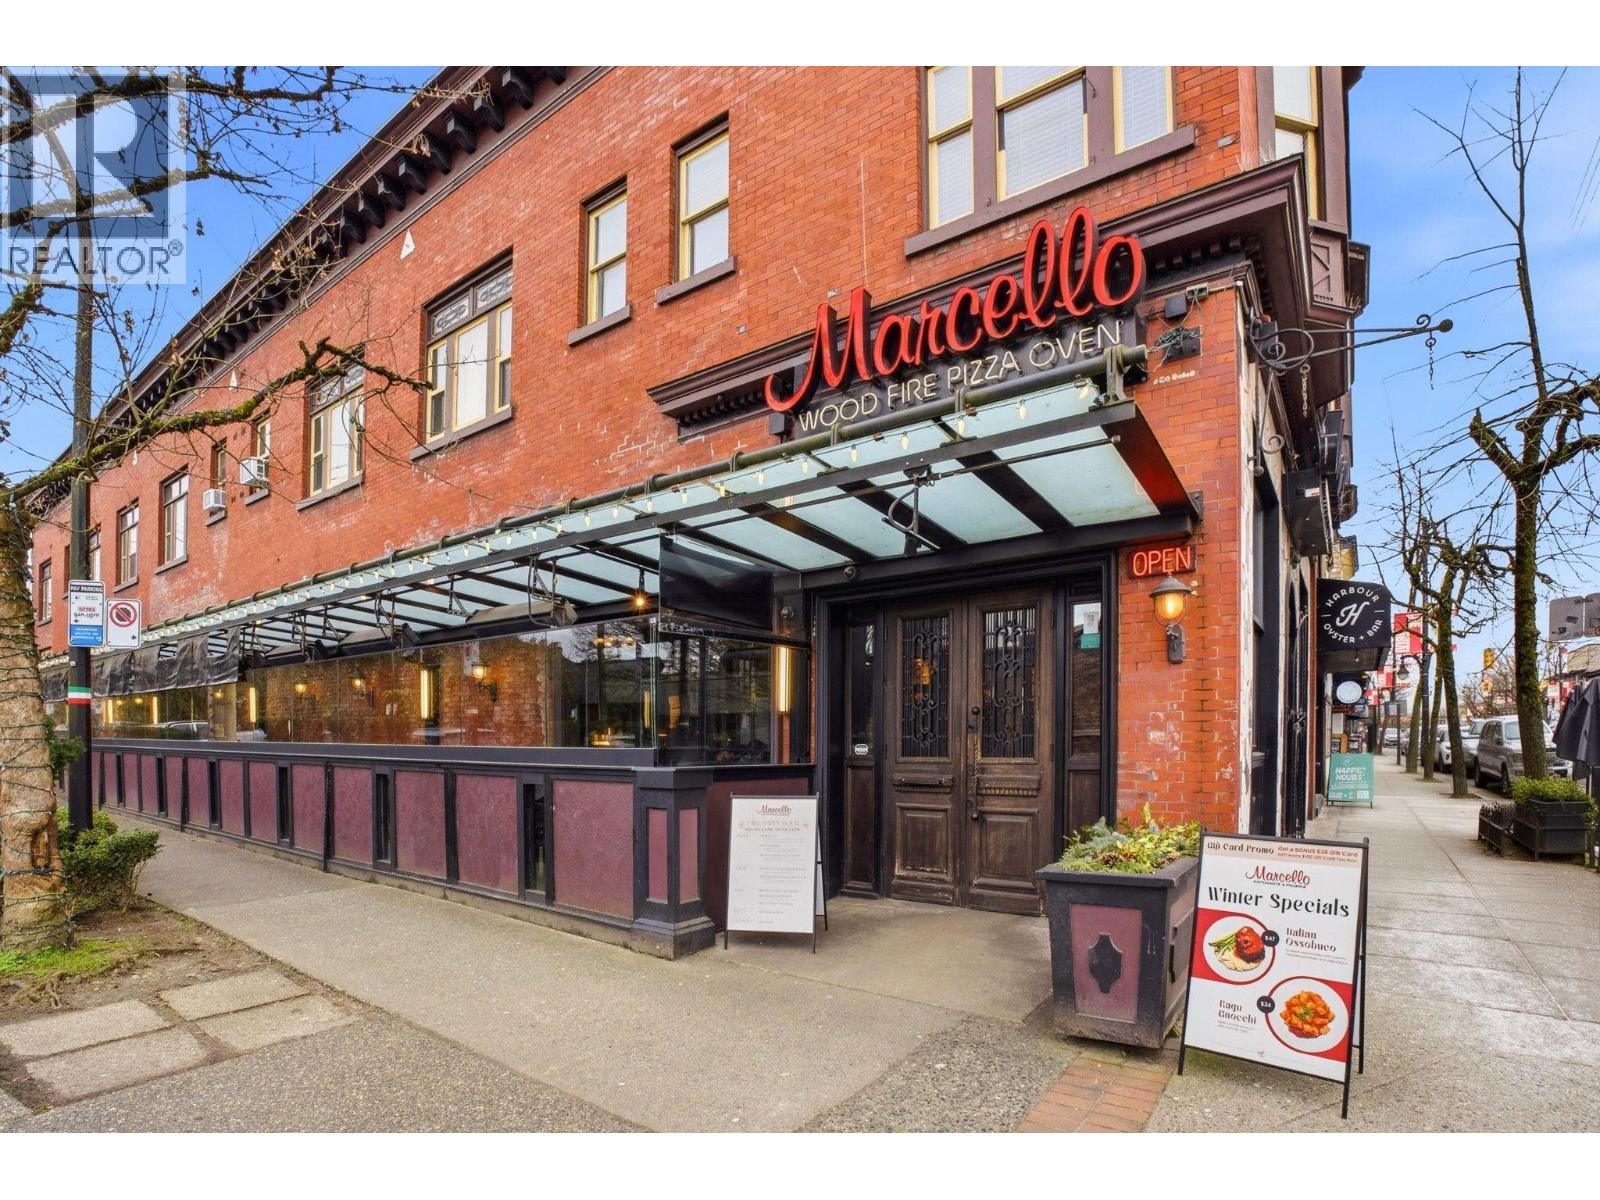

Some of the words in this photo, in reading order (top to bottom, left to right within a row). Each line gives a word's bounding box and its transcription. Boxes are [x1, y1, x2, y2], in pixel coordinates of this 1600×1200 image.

[764, 206, 1146, 412] Marcello
[798, 392, 878, 431] WOOD
[887, 373, 938, 406] FIRE
[947, 350, 1021, 389] PIZZA
[1029, 319, 1122, 368] OVEN
[1132, 546, 1191, 576] OPEN
[1325, 586, 1380, 607] HARBOUR
[1335, 601, 1371, 627] H
[1323, 623, 1355, 643] OYSTER
[1366, 619, 1383, 637] BAR
[1223, 843, 1244, 852] Card
[1247, 845, 1275, 855] Promo
[1245, 865, 1310, 886] Marcello
[1208, 886, 1263, 906] Winter
[1269, 893, 1350, 918] Specials
[1285, 937, 1337, 952] Ossobuco
[1286, 927, 1317, 940] Italian
[1218, 1009, 1257, 1025] Gnocchi
